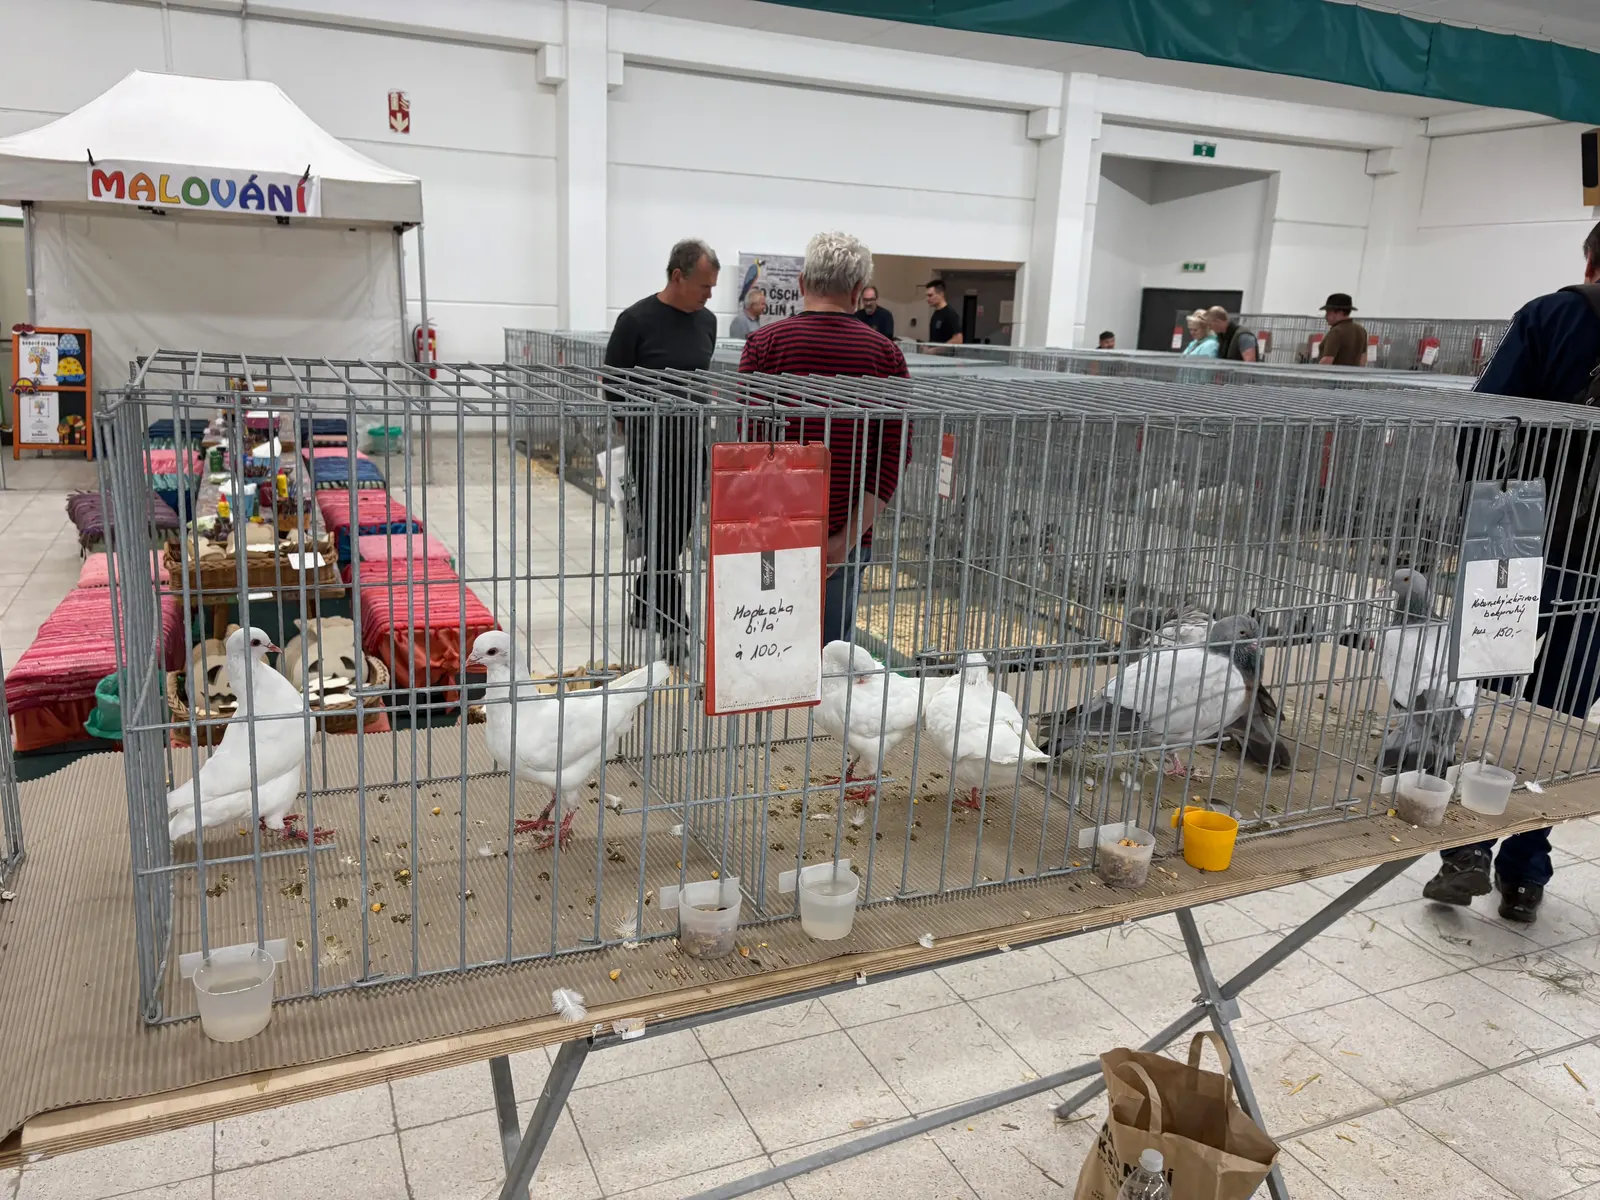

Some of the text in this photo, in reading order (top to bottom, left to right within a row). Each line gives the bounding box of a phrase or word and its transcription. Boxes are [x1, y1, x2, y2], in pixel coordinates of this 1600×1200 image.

[92, 169, 306, 213] MALOVÁNÍ
[769, 284, 799, 301] ČSCH
[762, 301, 787, 316] OLÍN
